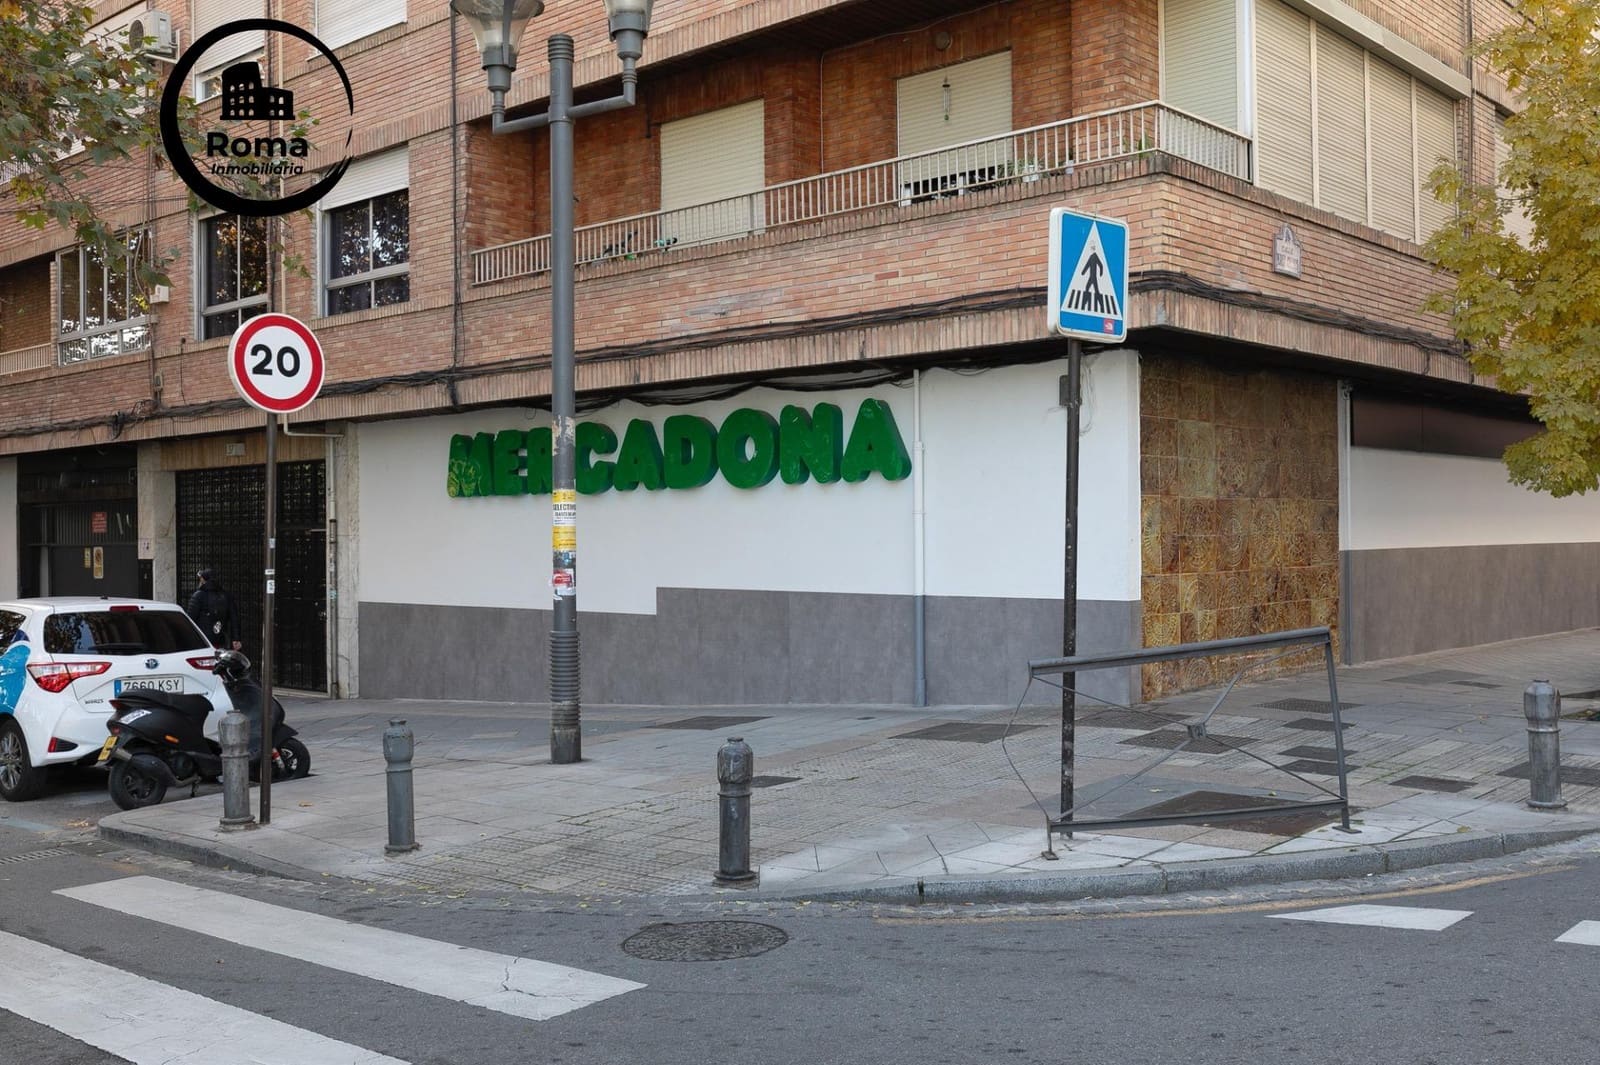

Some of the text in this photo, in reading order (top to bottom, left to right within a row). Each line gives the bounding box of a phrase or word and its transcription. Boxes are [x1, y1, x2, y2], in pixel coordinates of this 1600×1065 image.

[251, 344, 300, 377] 20
[447, 398, 912, 497] MERCADONA
[158, 679, 180, 692] KSY
